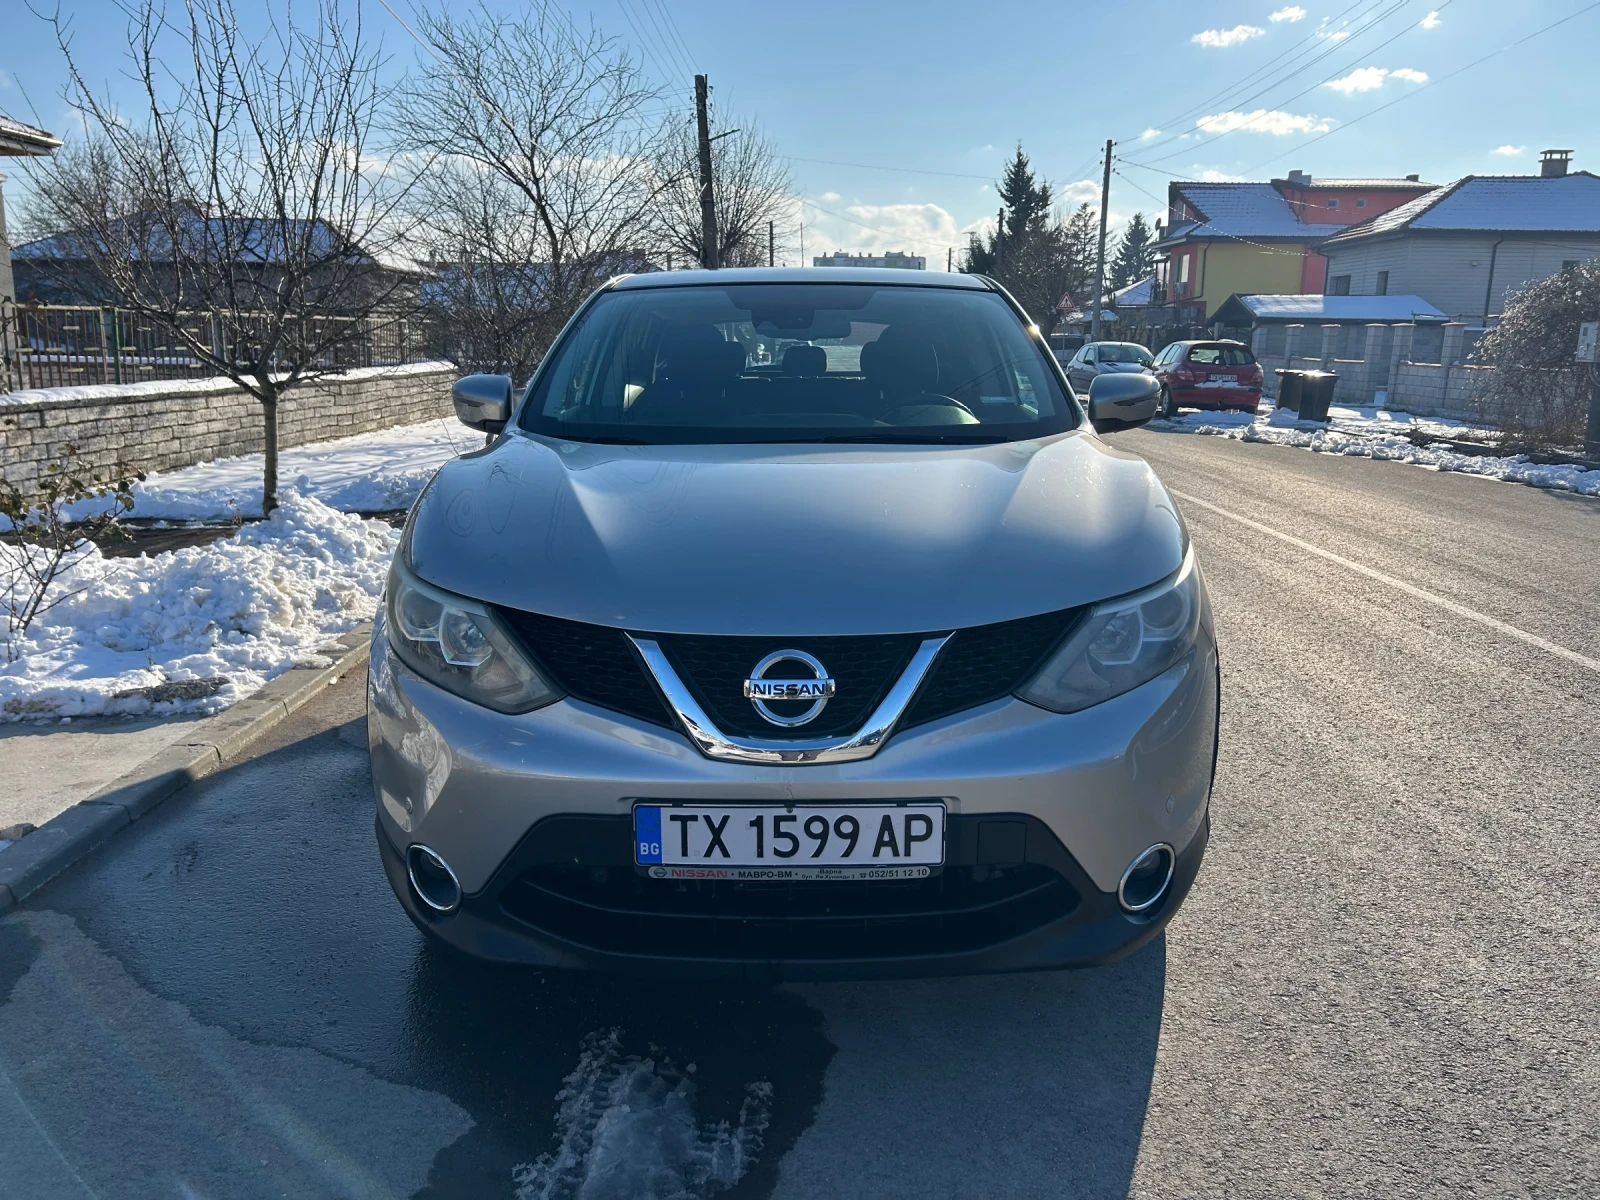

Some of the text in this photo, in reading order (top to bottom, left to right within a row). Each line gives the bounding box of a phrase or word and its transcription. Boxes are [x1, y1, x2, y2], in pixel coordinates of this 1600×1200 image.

[753, 683, 826, 695] NISSAN
[669, 813, 934, 858] TX 1599 AP
[640, 842, 660, 855] BG
[671, 868, 728, 878] NISSAN
[738, 870, 793, 879] МАВРО-ВМ
[868, 868, 928, 878] 052/51 12 10
